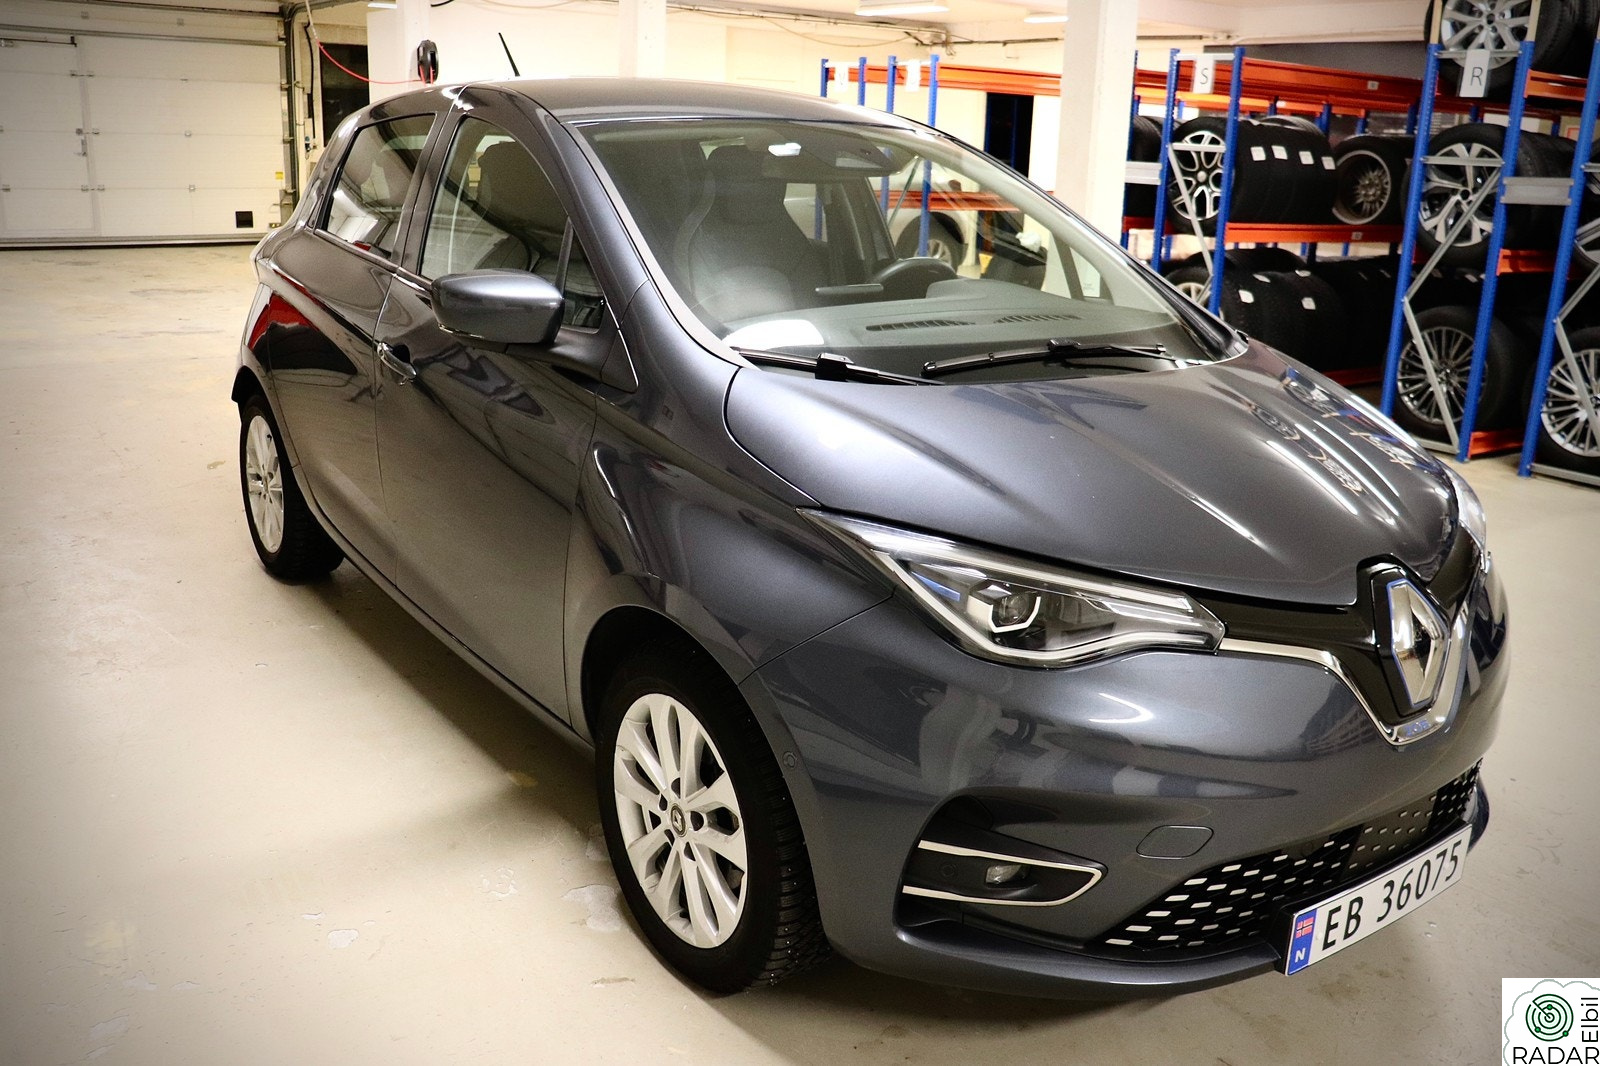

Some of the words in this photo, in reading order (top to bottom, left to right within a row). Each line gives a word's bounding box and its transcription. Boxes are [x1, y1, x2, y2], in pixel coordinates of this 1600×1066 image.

[1200, 67, 1209, 85] S
[1470, 66, 1483, 86] R
[1322, 896, 1364, 951] EB
[1376, 839, 1462, 923] 36075
[1294, 947, 1306, 963] N
